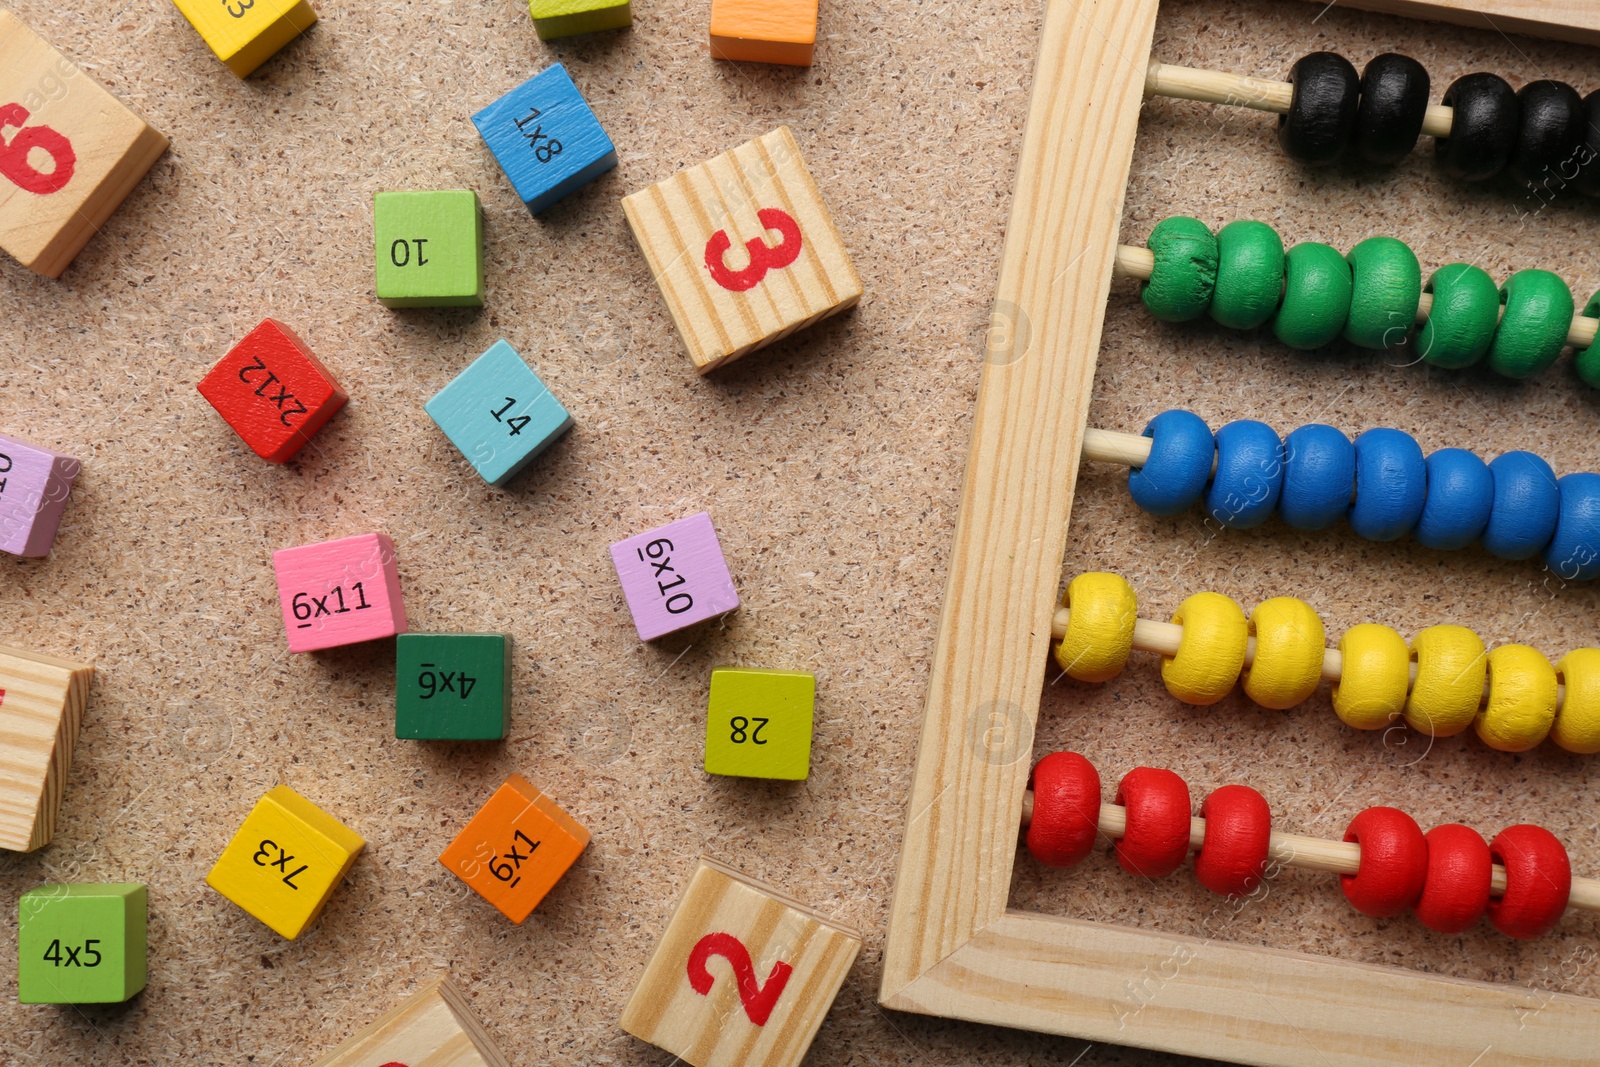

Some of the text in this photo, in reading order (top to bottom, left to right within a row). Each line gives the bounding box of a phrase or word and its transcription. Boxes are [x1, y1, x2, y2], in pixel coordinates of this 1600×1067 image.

[514, 108, 562, 163] 1x8
[391, 239, 428, 266] 10
[705, 209, 802, 292] 3
[239, 356, 307, 426] 2x12
[491, 397, 531, 436] 14
[639, 538, 693, 614] 6x10
[293, 582, 371, 628] 6x11
[419, 663, 476, 699] 4x6
[731, 717, 768, 744] 28
[253, 840, 308, 890] 7x3
[489, 830, 540, 888] 6x1
[44, 940, 101, 967] 4x5
[687, 932, 793, 1027] 2
